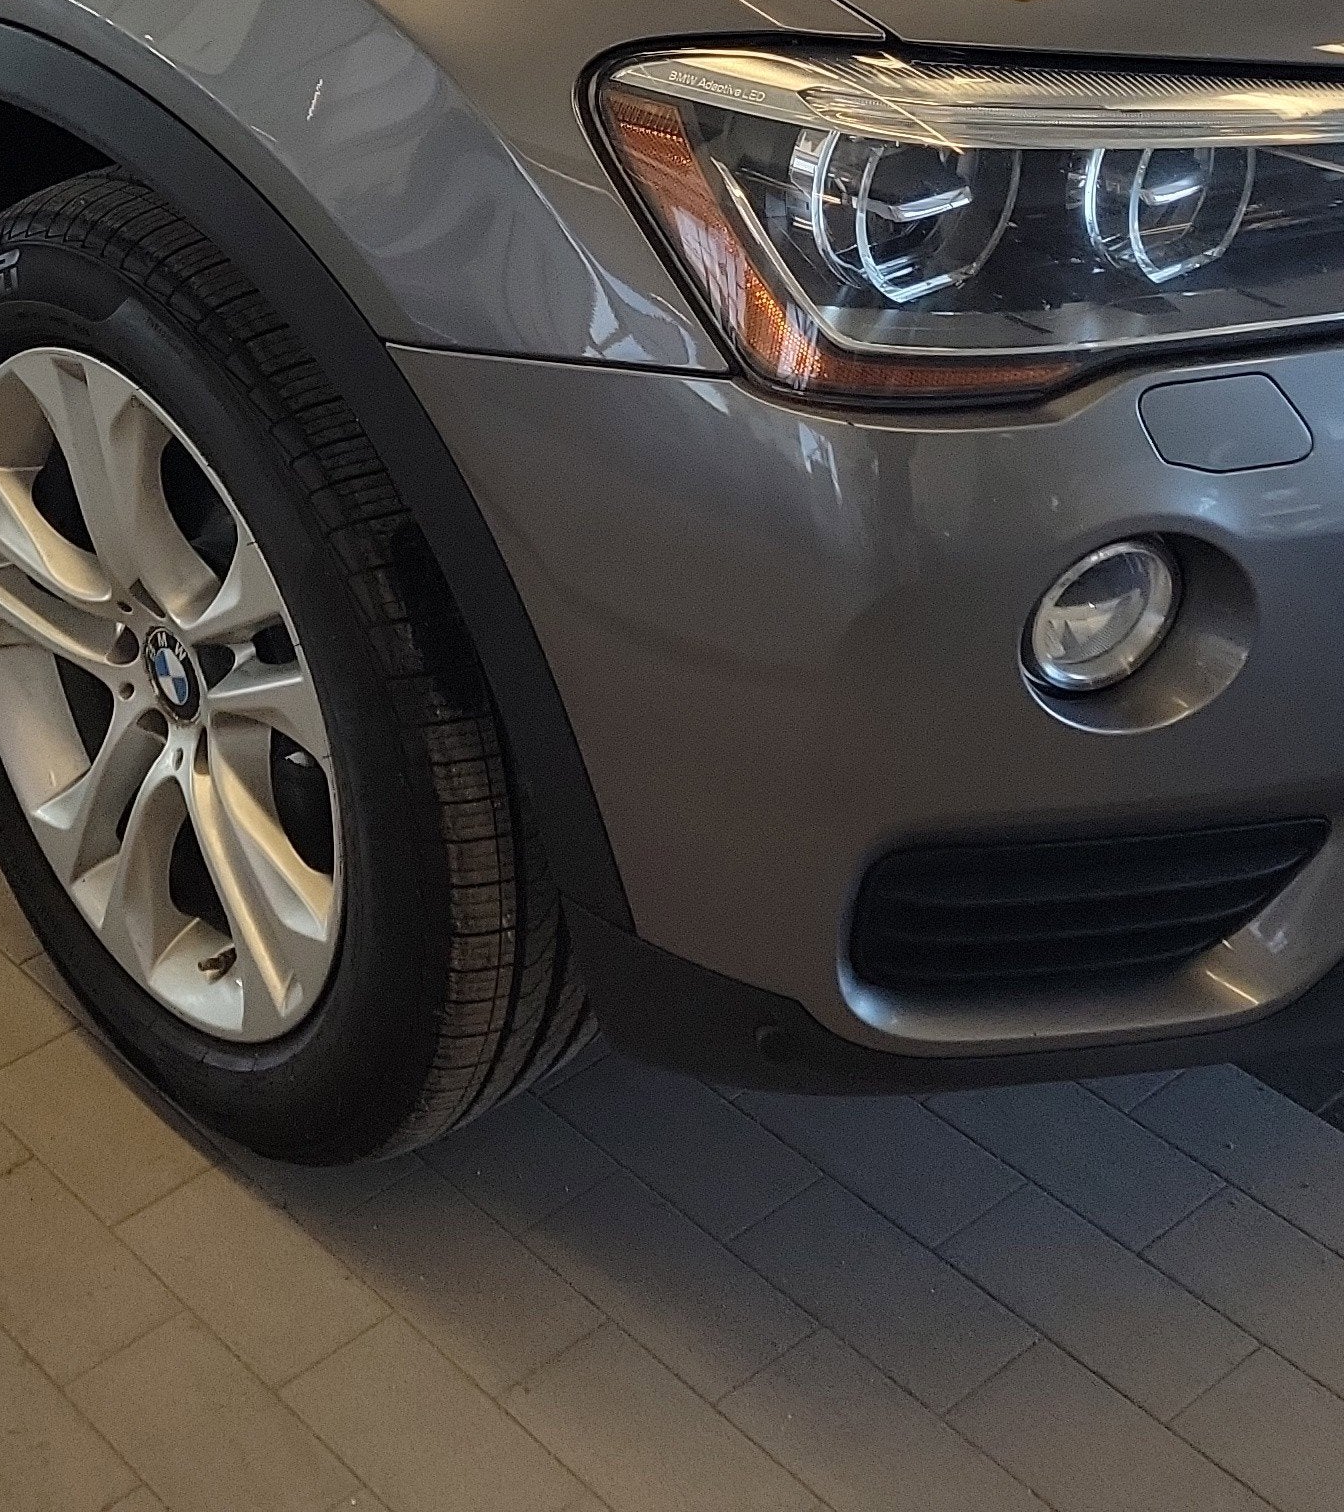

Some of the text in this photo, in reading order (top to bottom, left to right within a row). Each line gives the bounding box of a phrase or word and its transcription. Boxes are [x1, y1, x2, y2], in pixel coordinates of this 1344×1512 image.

[668, 70, 766, 102] BMW Adaptive LED
